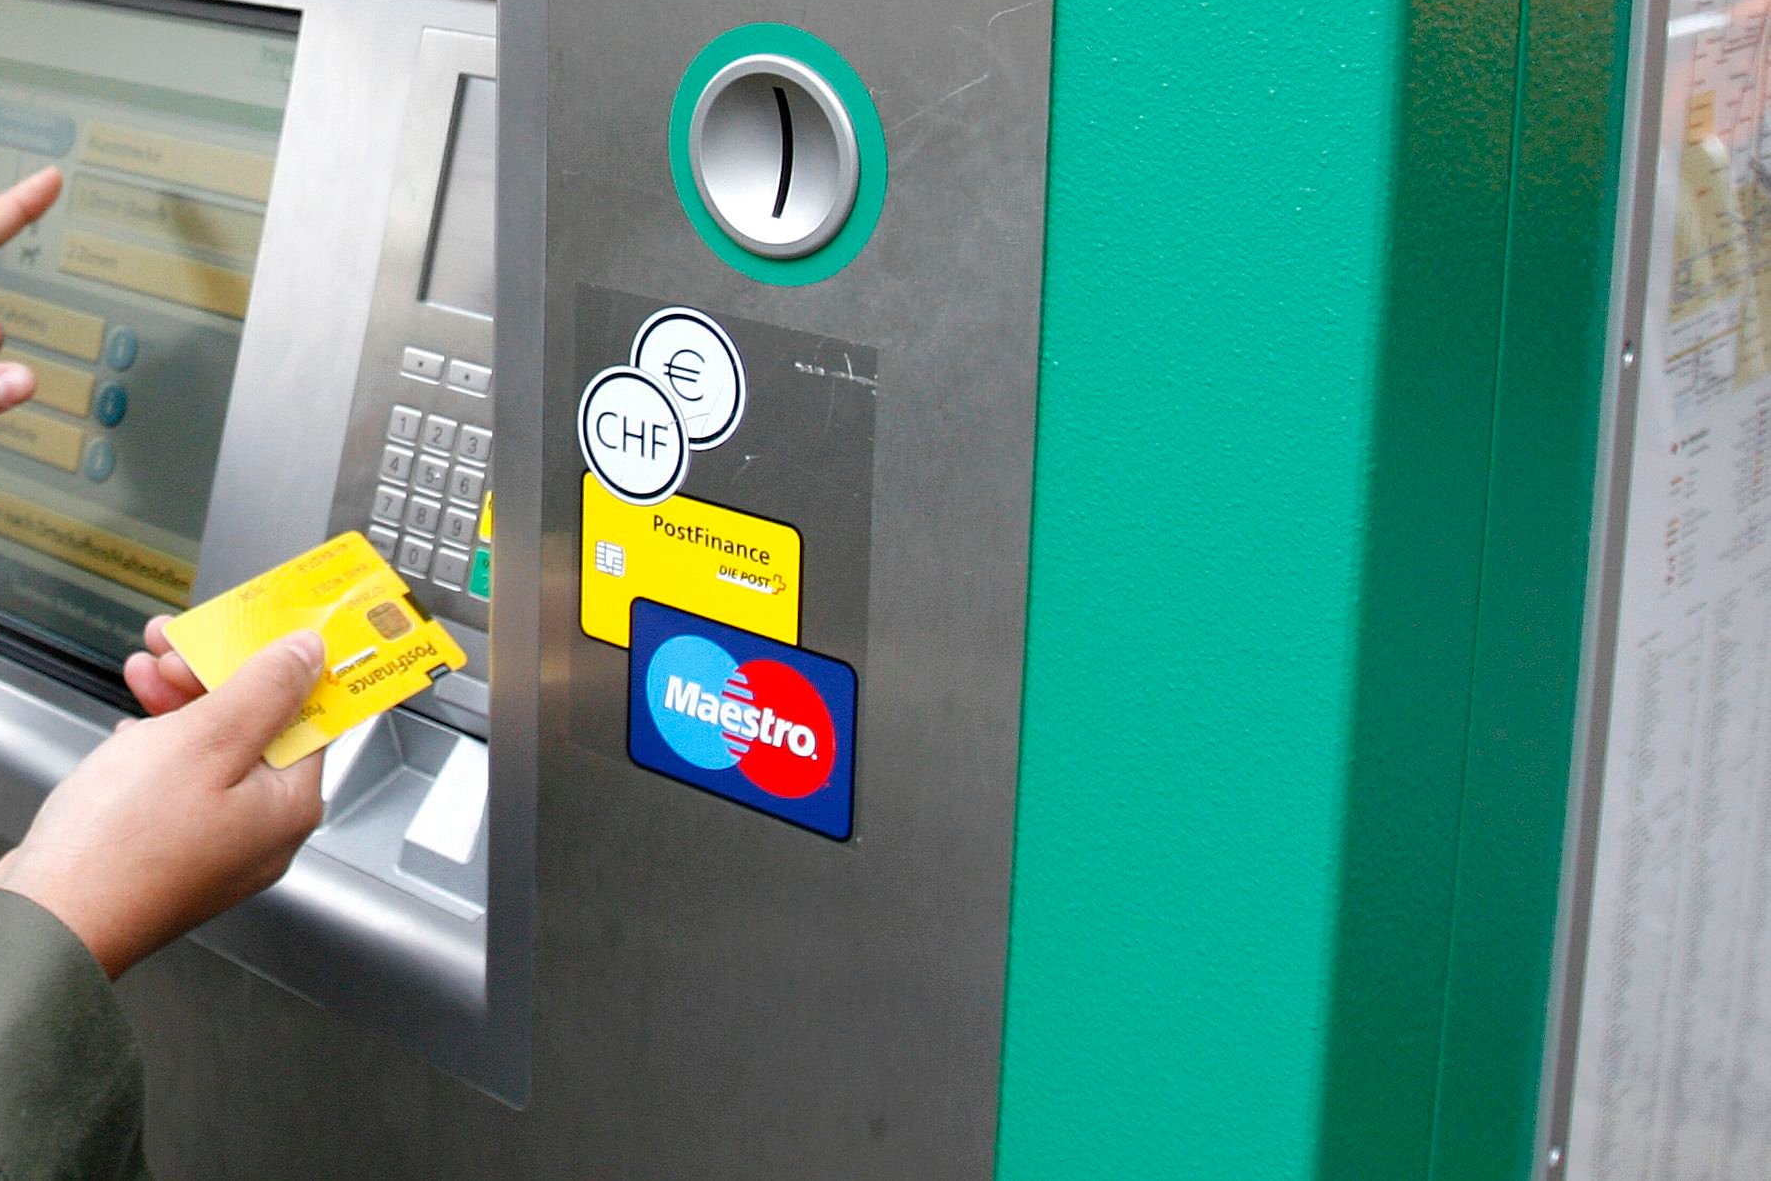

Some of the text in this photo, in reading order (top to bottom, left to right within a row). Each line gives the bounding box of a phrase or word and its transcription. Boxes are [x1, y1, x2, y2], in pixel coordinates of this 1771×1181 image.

[432, 426, 442, 444] 2
[467, 436, 477, 455] 3
[595, 411, 669, 460] CHF
[389, 456, 469, 494] 4 5 6
[383, 496, 462, 538] 7 8 9
[408, 547, 419, 566] 0
[653, 514, 771, 566] PostFinance
[718, 564, 771, 589] DIE POST
[347, 641, 438, 696] PostFinance
